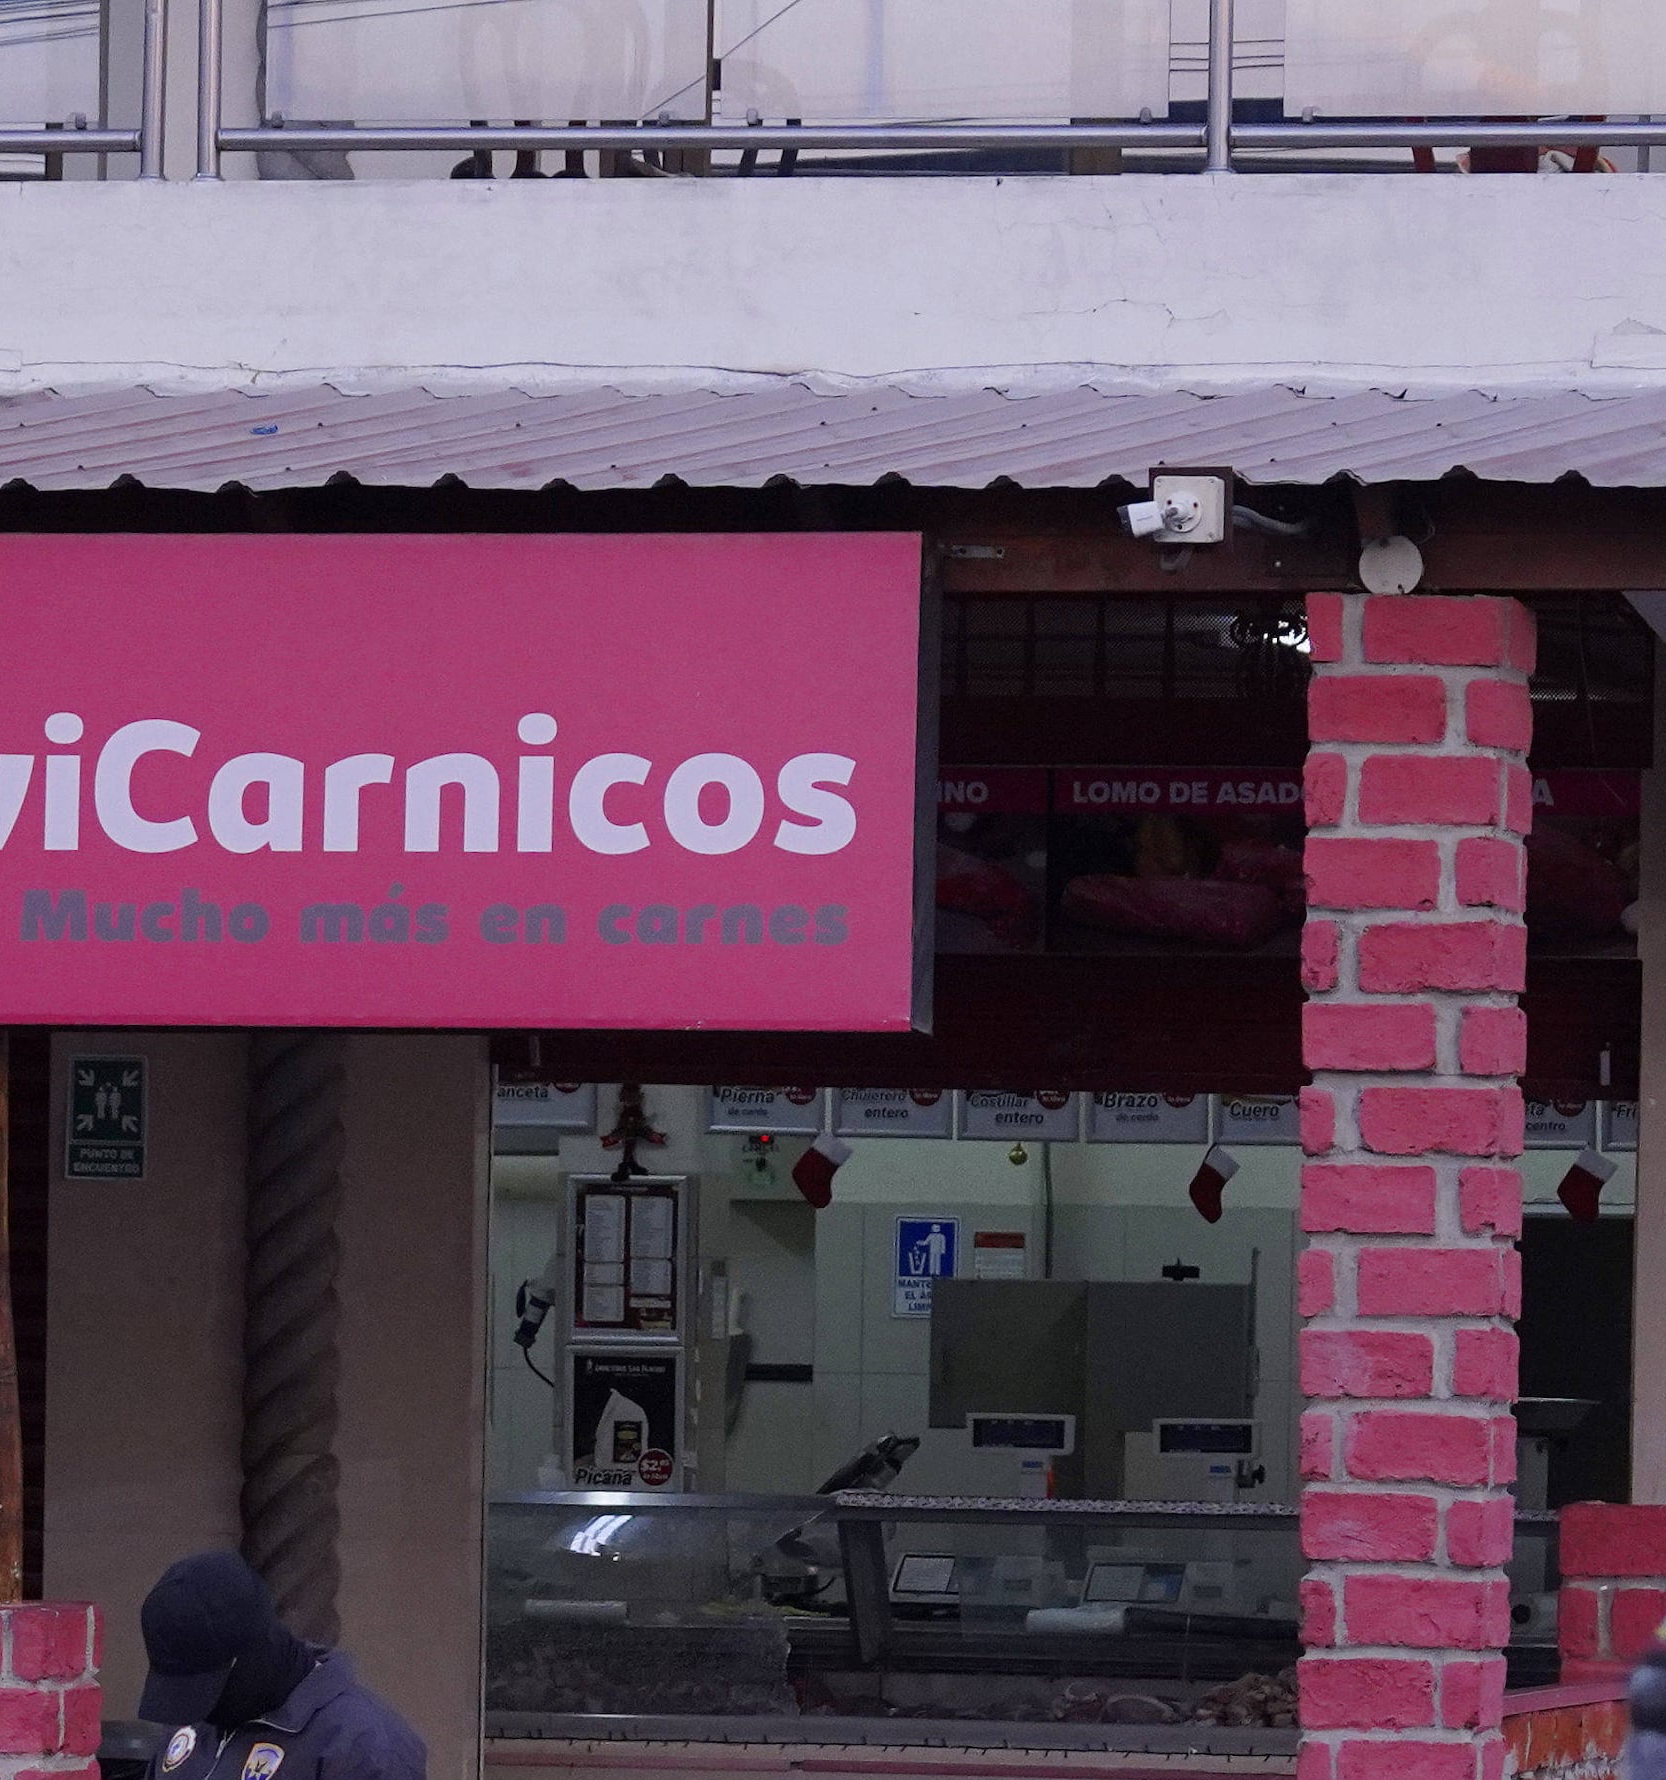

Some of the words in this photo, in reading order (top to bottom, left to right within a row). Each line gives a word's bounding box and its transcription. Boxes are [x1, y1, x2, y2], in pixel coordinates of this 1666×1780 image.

[1073, 781, 1161, 804] LOMO
[1169, 782, 1208, 803] DE
[1216, 781, 1305, 804] ASAD
[20, 889, 271, 947] Mucho
[299, 883, 451, 947] más
[480, 902, 567, 946] en
[598, 900, 851, 947] carnes
[497, 1084, 549, 1099] anceta
[864, 1107, 909, 1119] entero
[995, 1110, 1044, 1125] entero
